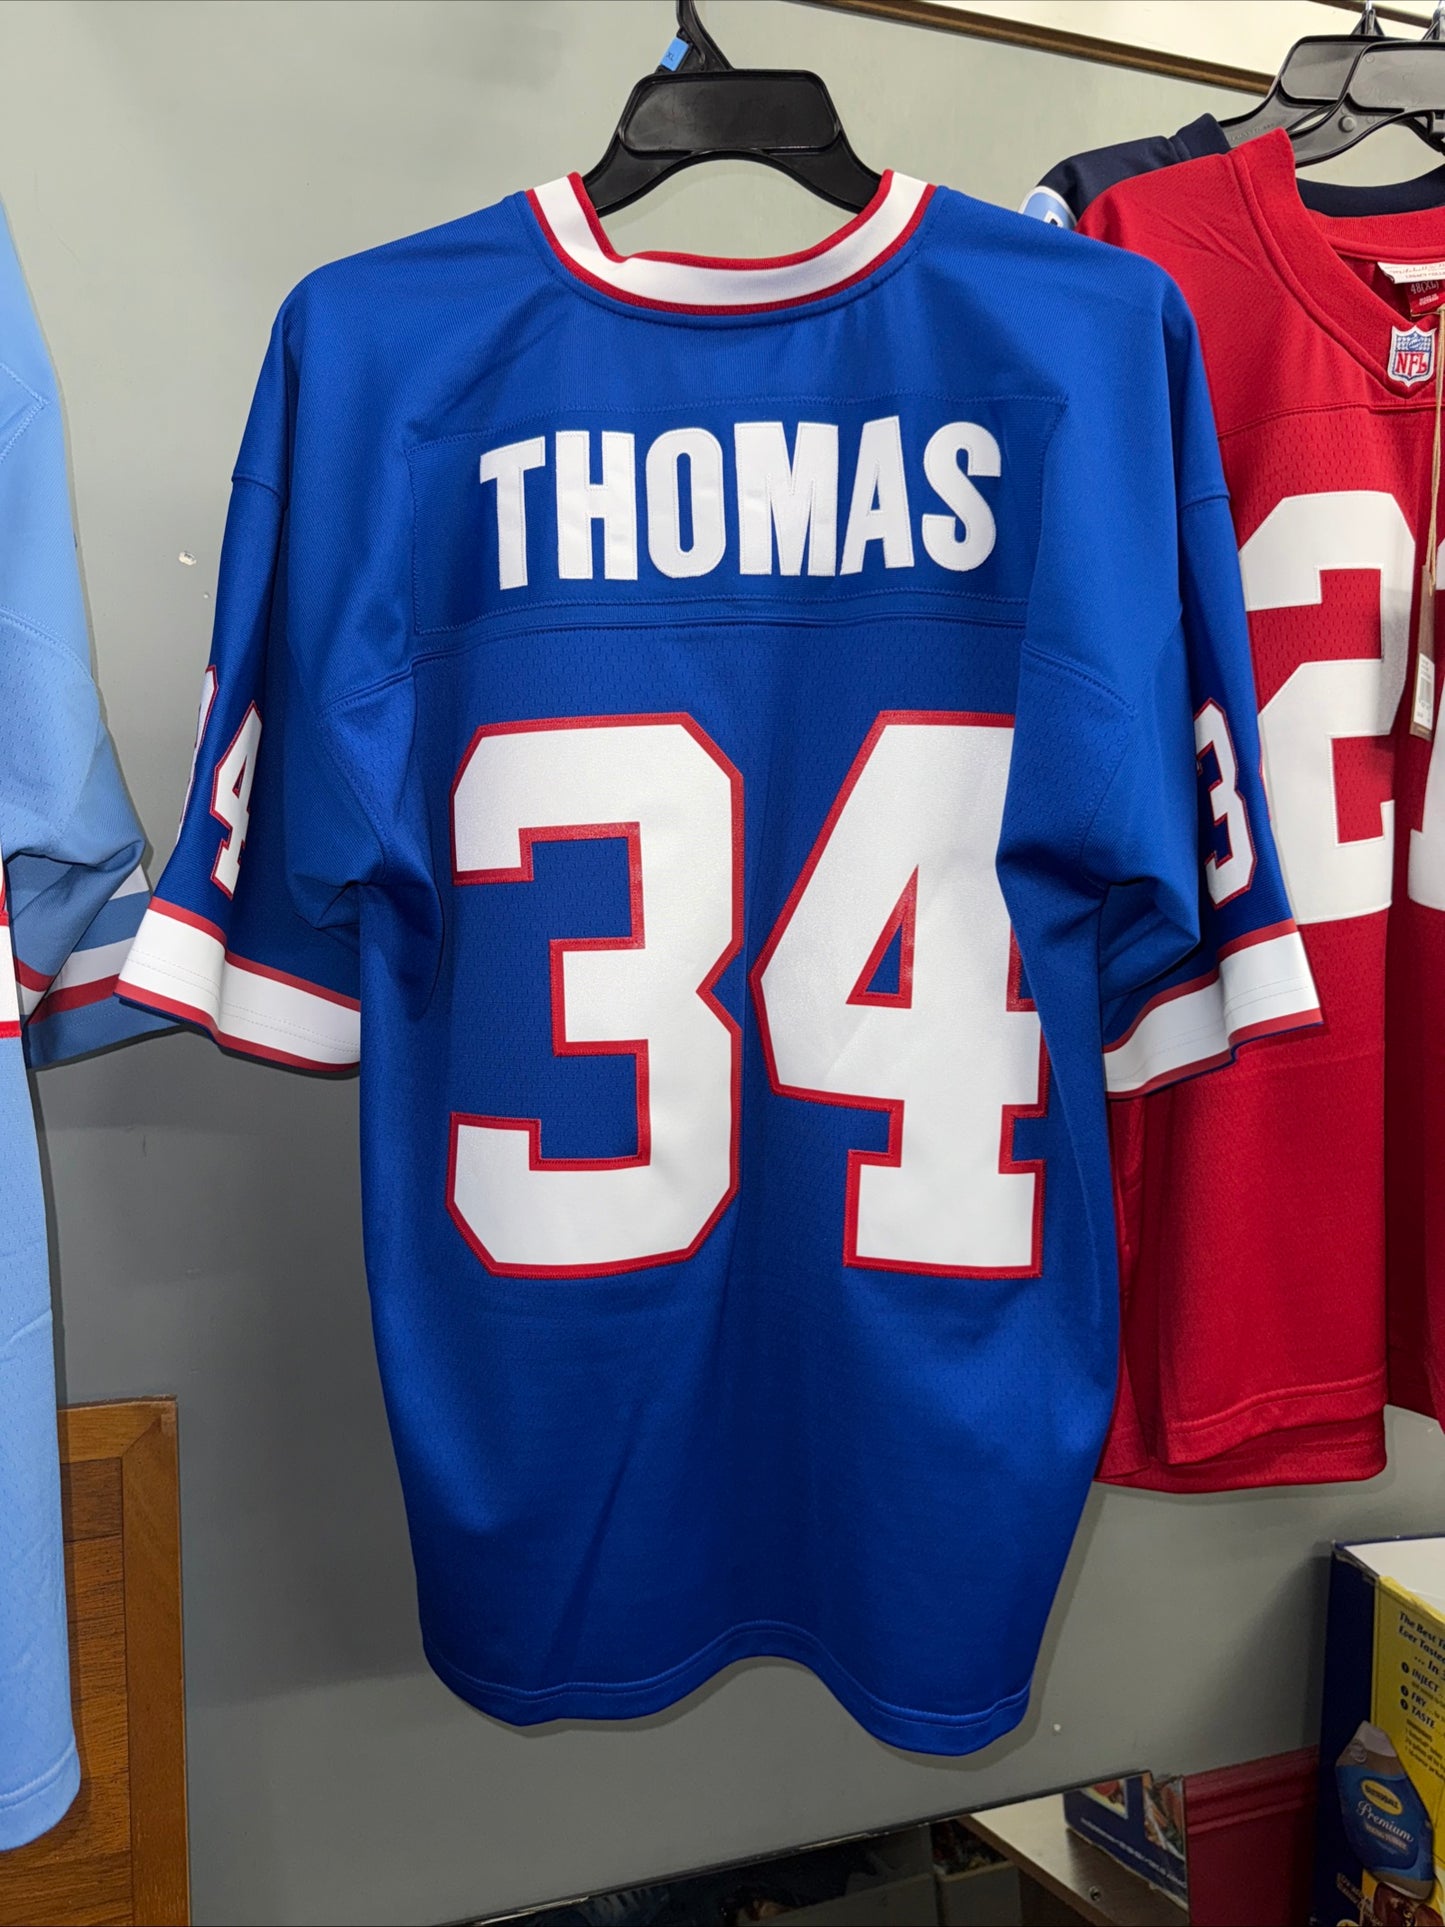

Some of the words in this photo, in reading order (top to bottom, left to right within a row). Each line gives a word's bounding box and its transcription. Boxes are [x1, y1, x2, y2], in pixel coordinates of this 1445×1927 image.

[1395, 351, 1428, 377] NFL
[479, 415, 1001, 590] THOMAS
[1238, 490, 1445, 925] 2
[445, 709, 1049, 1279] 34
[1398, 1625, 1417, 1643] Ever
[1399, 1611, 1415, 1628] The
[1416, 1623, 1436, 1643] Best
[1428, 1660, 1439, 1675] In
[1411, 1705, 1435, 1728] TASTE
[1356, 1800, 1415, 1842] Premium
